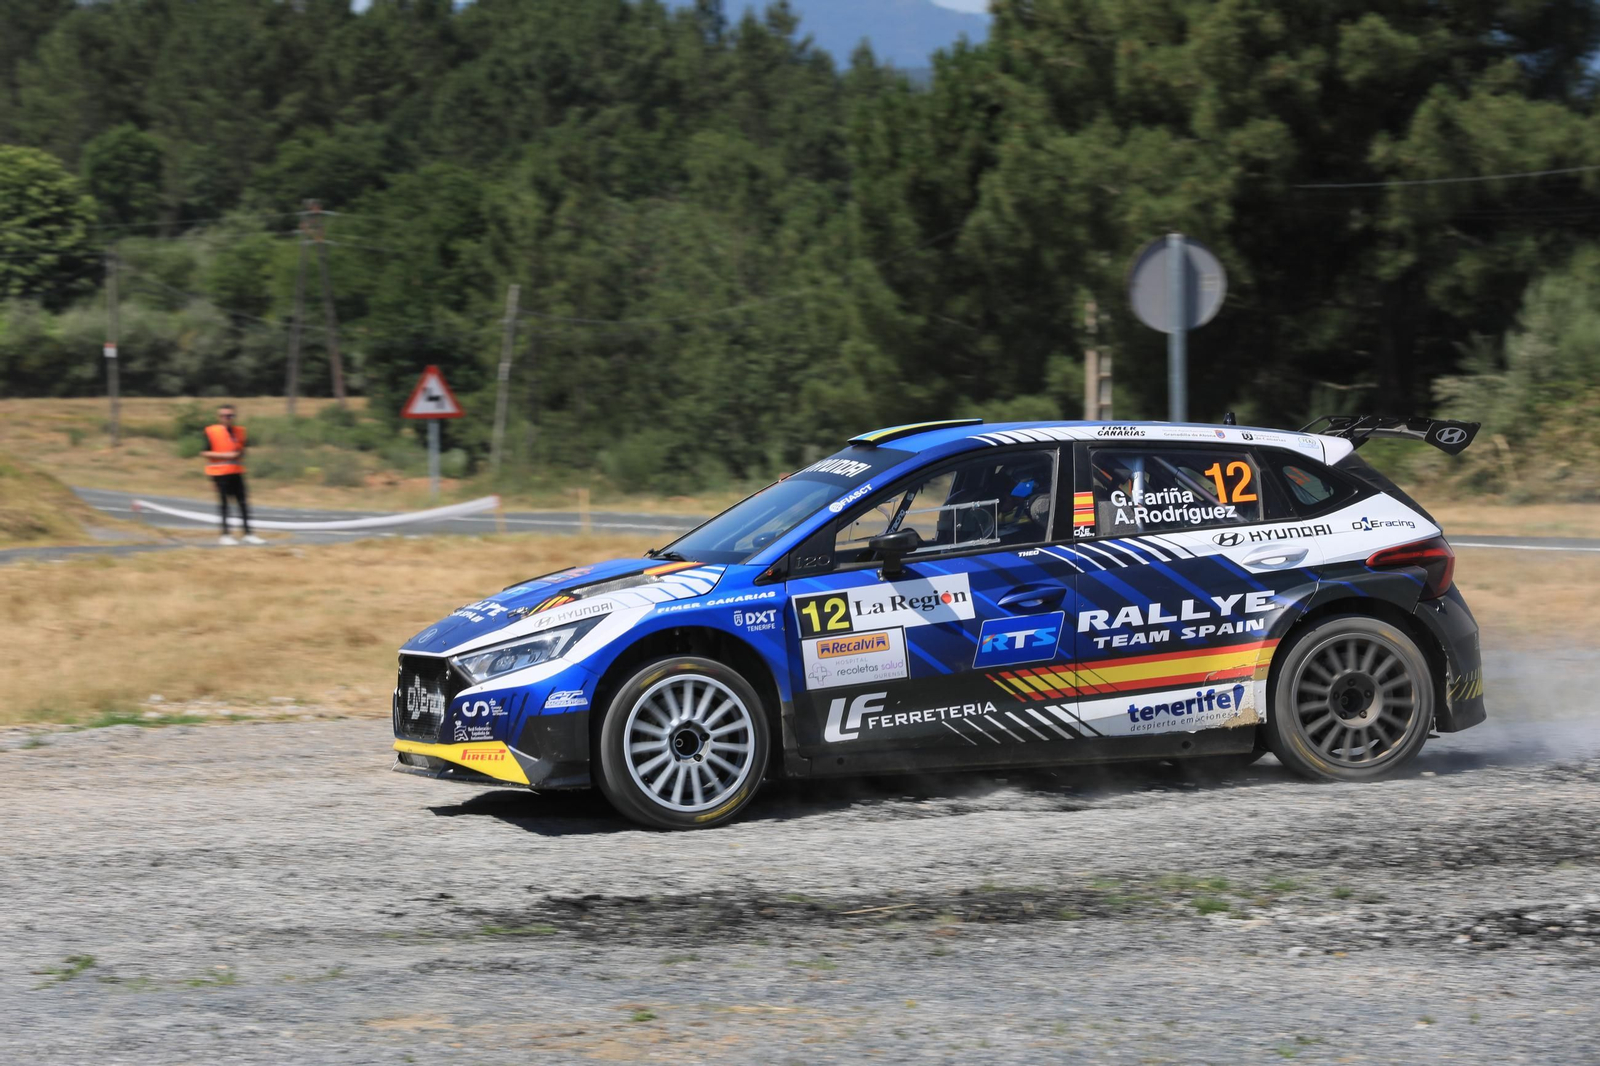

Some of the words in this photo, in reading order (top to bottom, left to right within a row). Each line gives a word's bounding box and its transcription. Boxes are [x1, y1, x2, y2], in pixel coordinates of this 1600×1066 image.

[1204, 461, 1257, 504] 12
[1249, 524, 1333, 542] HYUNDAI
[706, 591, 776, 606] CANARIAS
[557, 602, 613, 620] HYUNDAI
[745, 609, 777, 625] DXT
[801, 597, 850, 633] 12
[854, 600, 885, 617] La
[1077, 589, 1276, 633] RALLYE
[746, 623, 776, 632] TENERIFE
[1093, 629, 1170, 649] TEAM
[1180, 618, 1265, 640] SPAIN
[831, 637, 875, 654] Recalvi
[982, 626, 1056, 653] RTS
[835, 657, 868, 666] HOSPITAL
[836, 664, 879, 676] recoletas
[881, 659, 904, 670] salud
[873, 670, 905, 679] OURENSE
[823, 691, 888, 743] LF
[867, 701, 998, 730] FERRETERIA
[1130, 720, 1176, 732] despierta
[461, 749, 507, 761] PIRELLI
